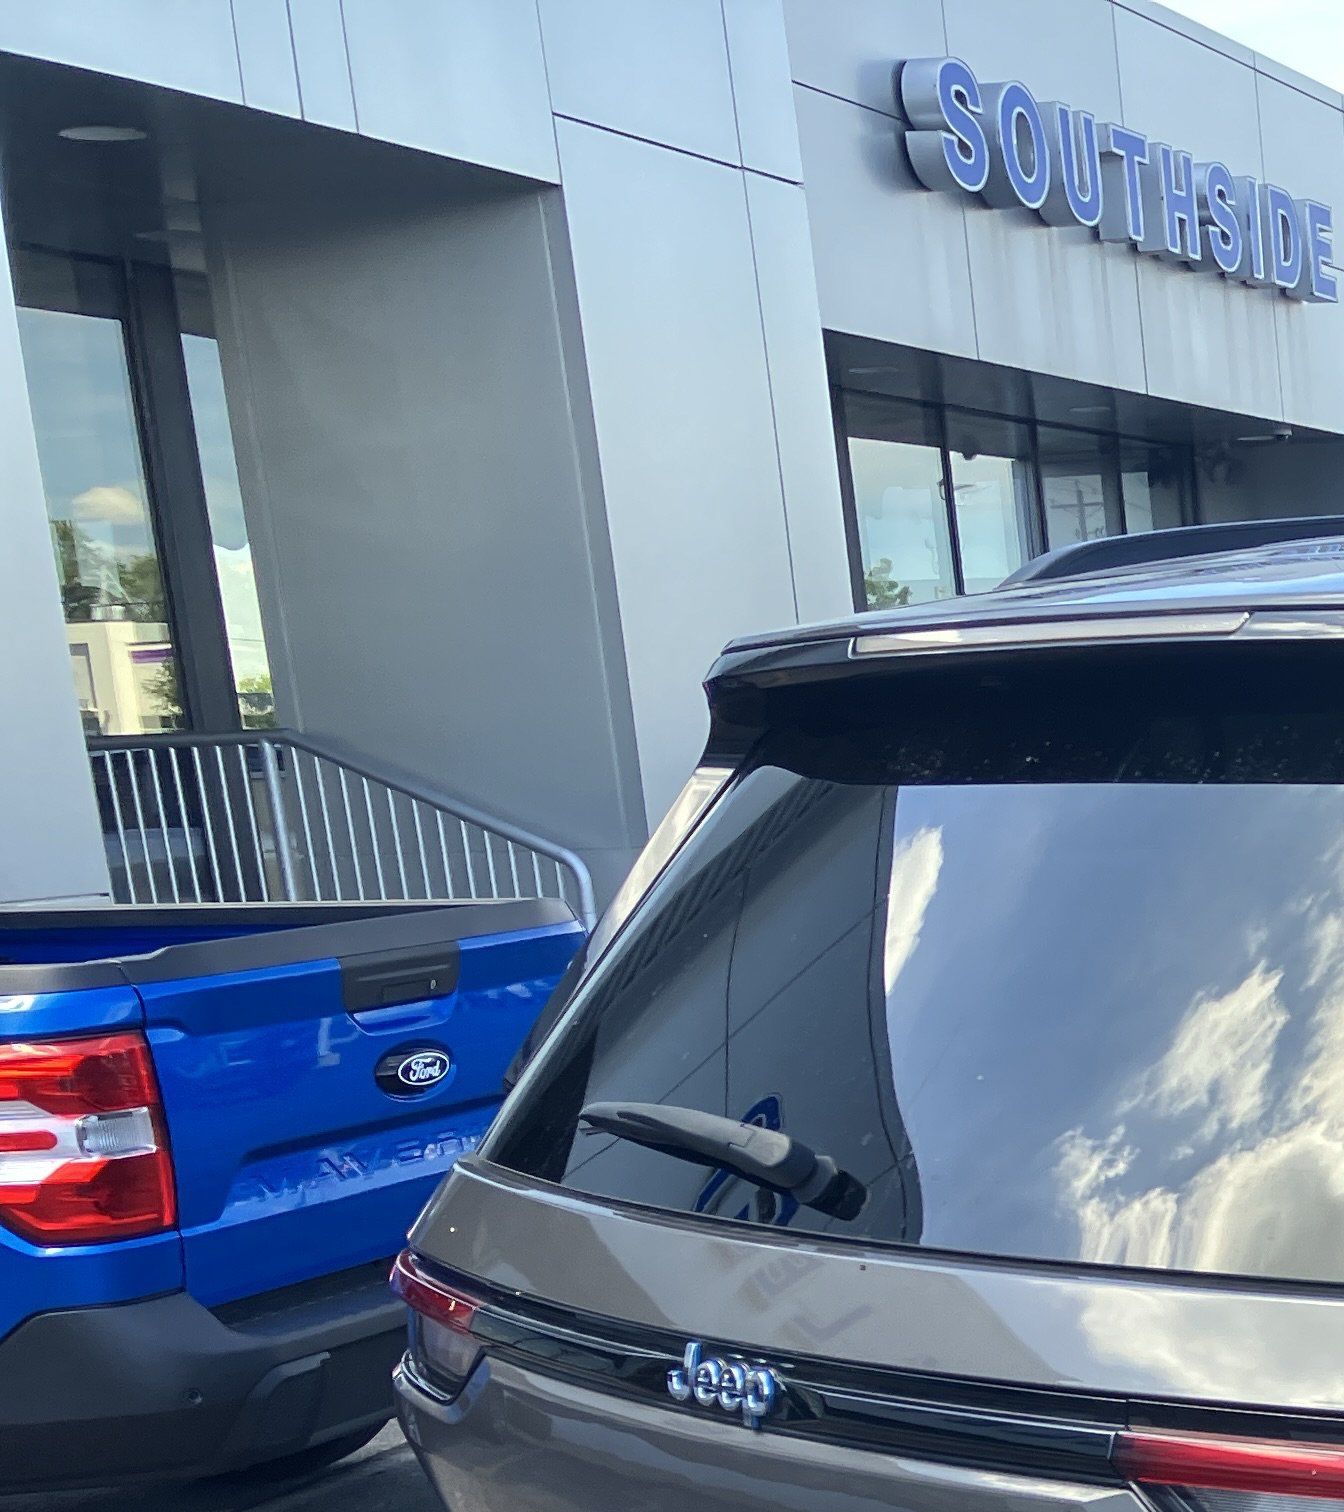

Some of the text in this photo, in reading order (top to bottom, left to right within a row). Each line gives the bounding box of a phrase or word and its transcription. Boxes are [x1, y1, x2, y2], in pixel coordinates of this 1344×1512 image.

[906, 56, 1339, 303] SOUTHSIDE
[405, 1055, 444, 1083] Ford
[667, 1341, 777, 1432] Jeep
